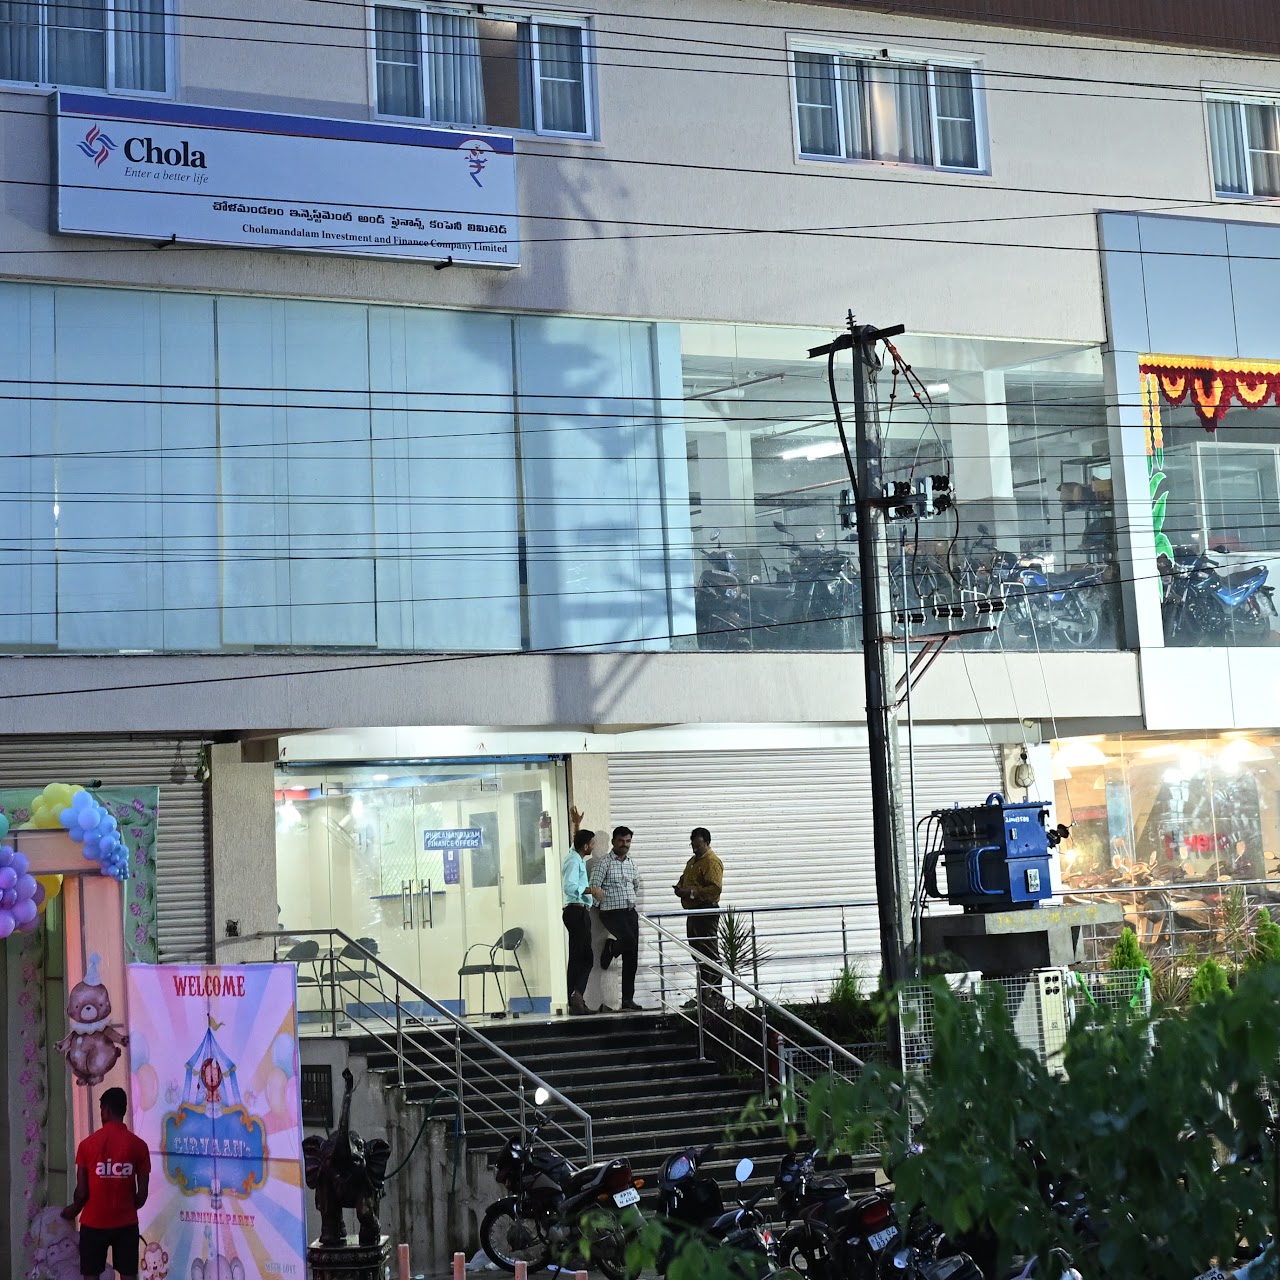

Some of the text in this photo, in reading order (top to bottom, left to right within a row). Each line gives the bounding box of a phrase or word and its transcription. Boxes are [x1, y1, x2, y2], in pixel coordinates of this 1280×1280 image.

[124, 137, 207, 169] Chola
[124, 167, 209, 186] Enter a better life
[242, 223, 508, 253] Cholamandalam Investment and Finance Company Limited
[173, 975, 246, 997] WELCOME
[95, 1158, 133, 1176] aica
[180, 1210, 255, 1227] CARNIVAL PARTY
